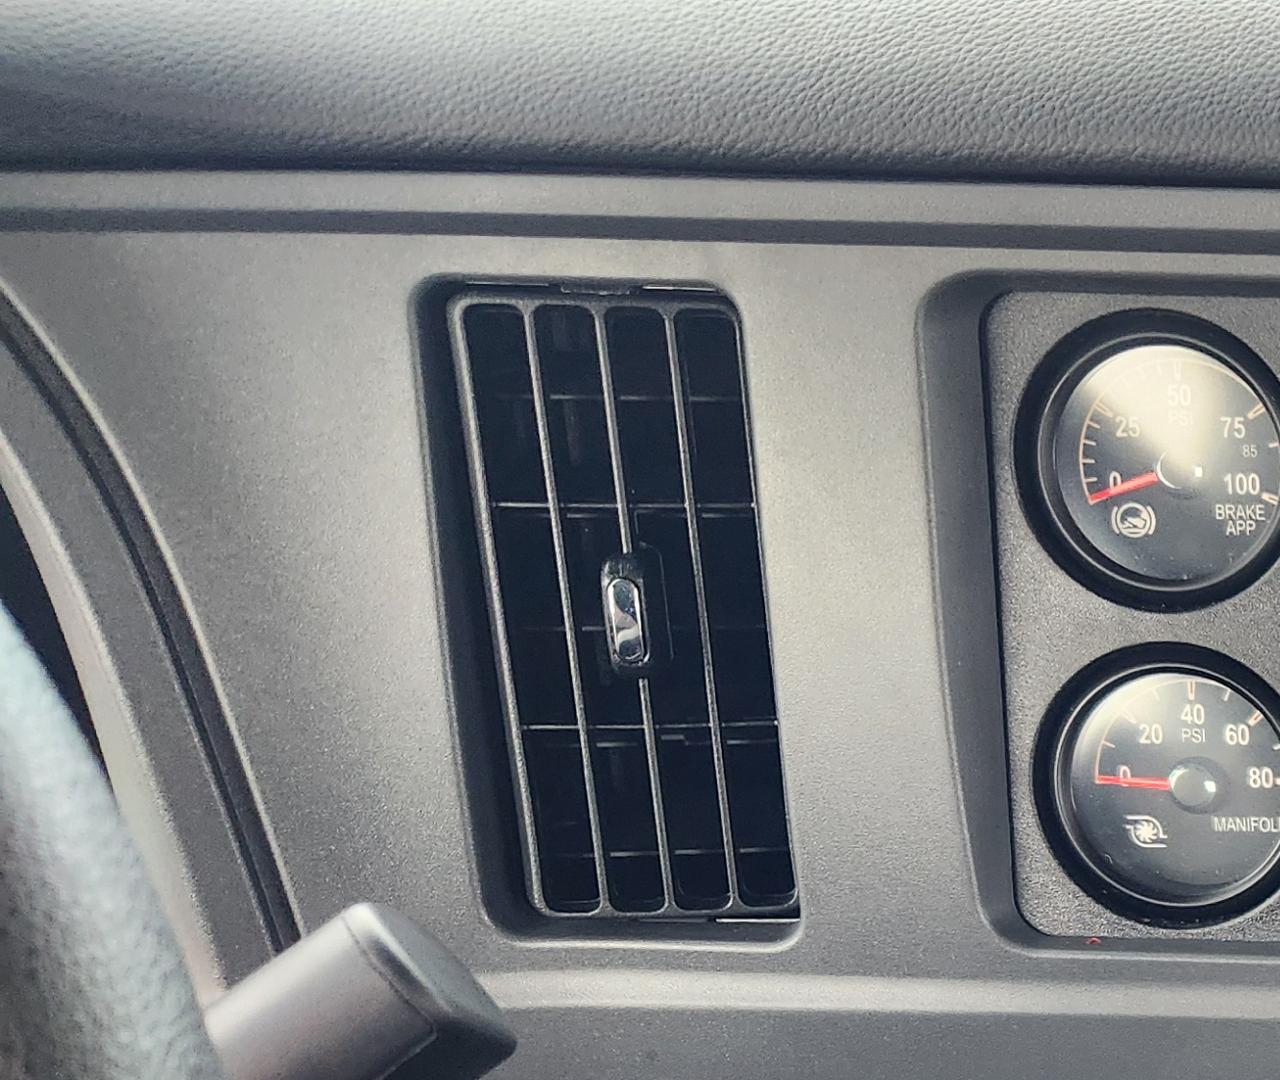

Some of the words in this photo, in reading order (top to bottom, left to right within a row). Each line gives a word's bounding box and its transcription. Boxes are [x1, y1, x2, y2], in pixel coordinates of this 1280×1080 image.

[1168, 384, 1191, 406] 50
[1116, 417, 1140, 437] 25
[1220, 417, 1245, 438] 75
[1243, 444, 1257, 458] 85
[1224, 474, 1260, 495] 100
[1215, 504, 1266, 520] BRAKE
[1226, 520, 1256, 535] APP
[1180, 704, 1205, 725] 40
[1139, 724, 1163, 744] 20
[1182, 728, 1206, 742] PSI
[1225, 724, 1249, 745] 60
[1250, 768, 1273, 788] 80
